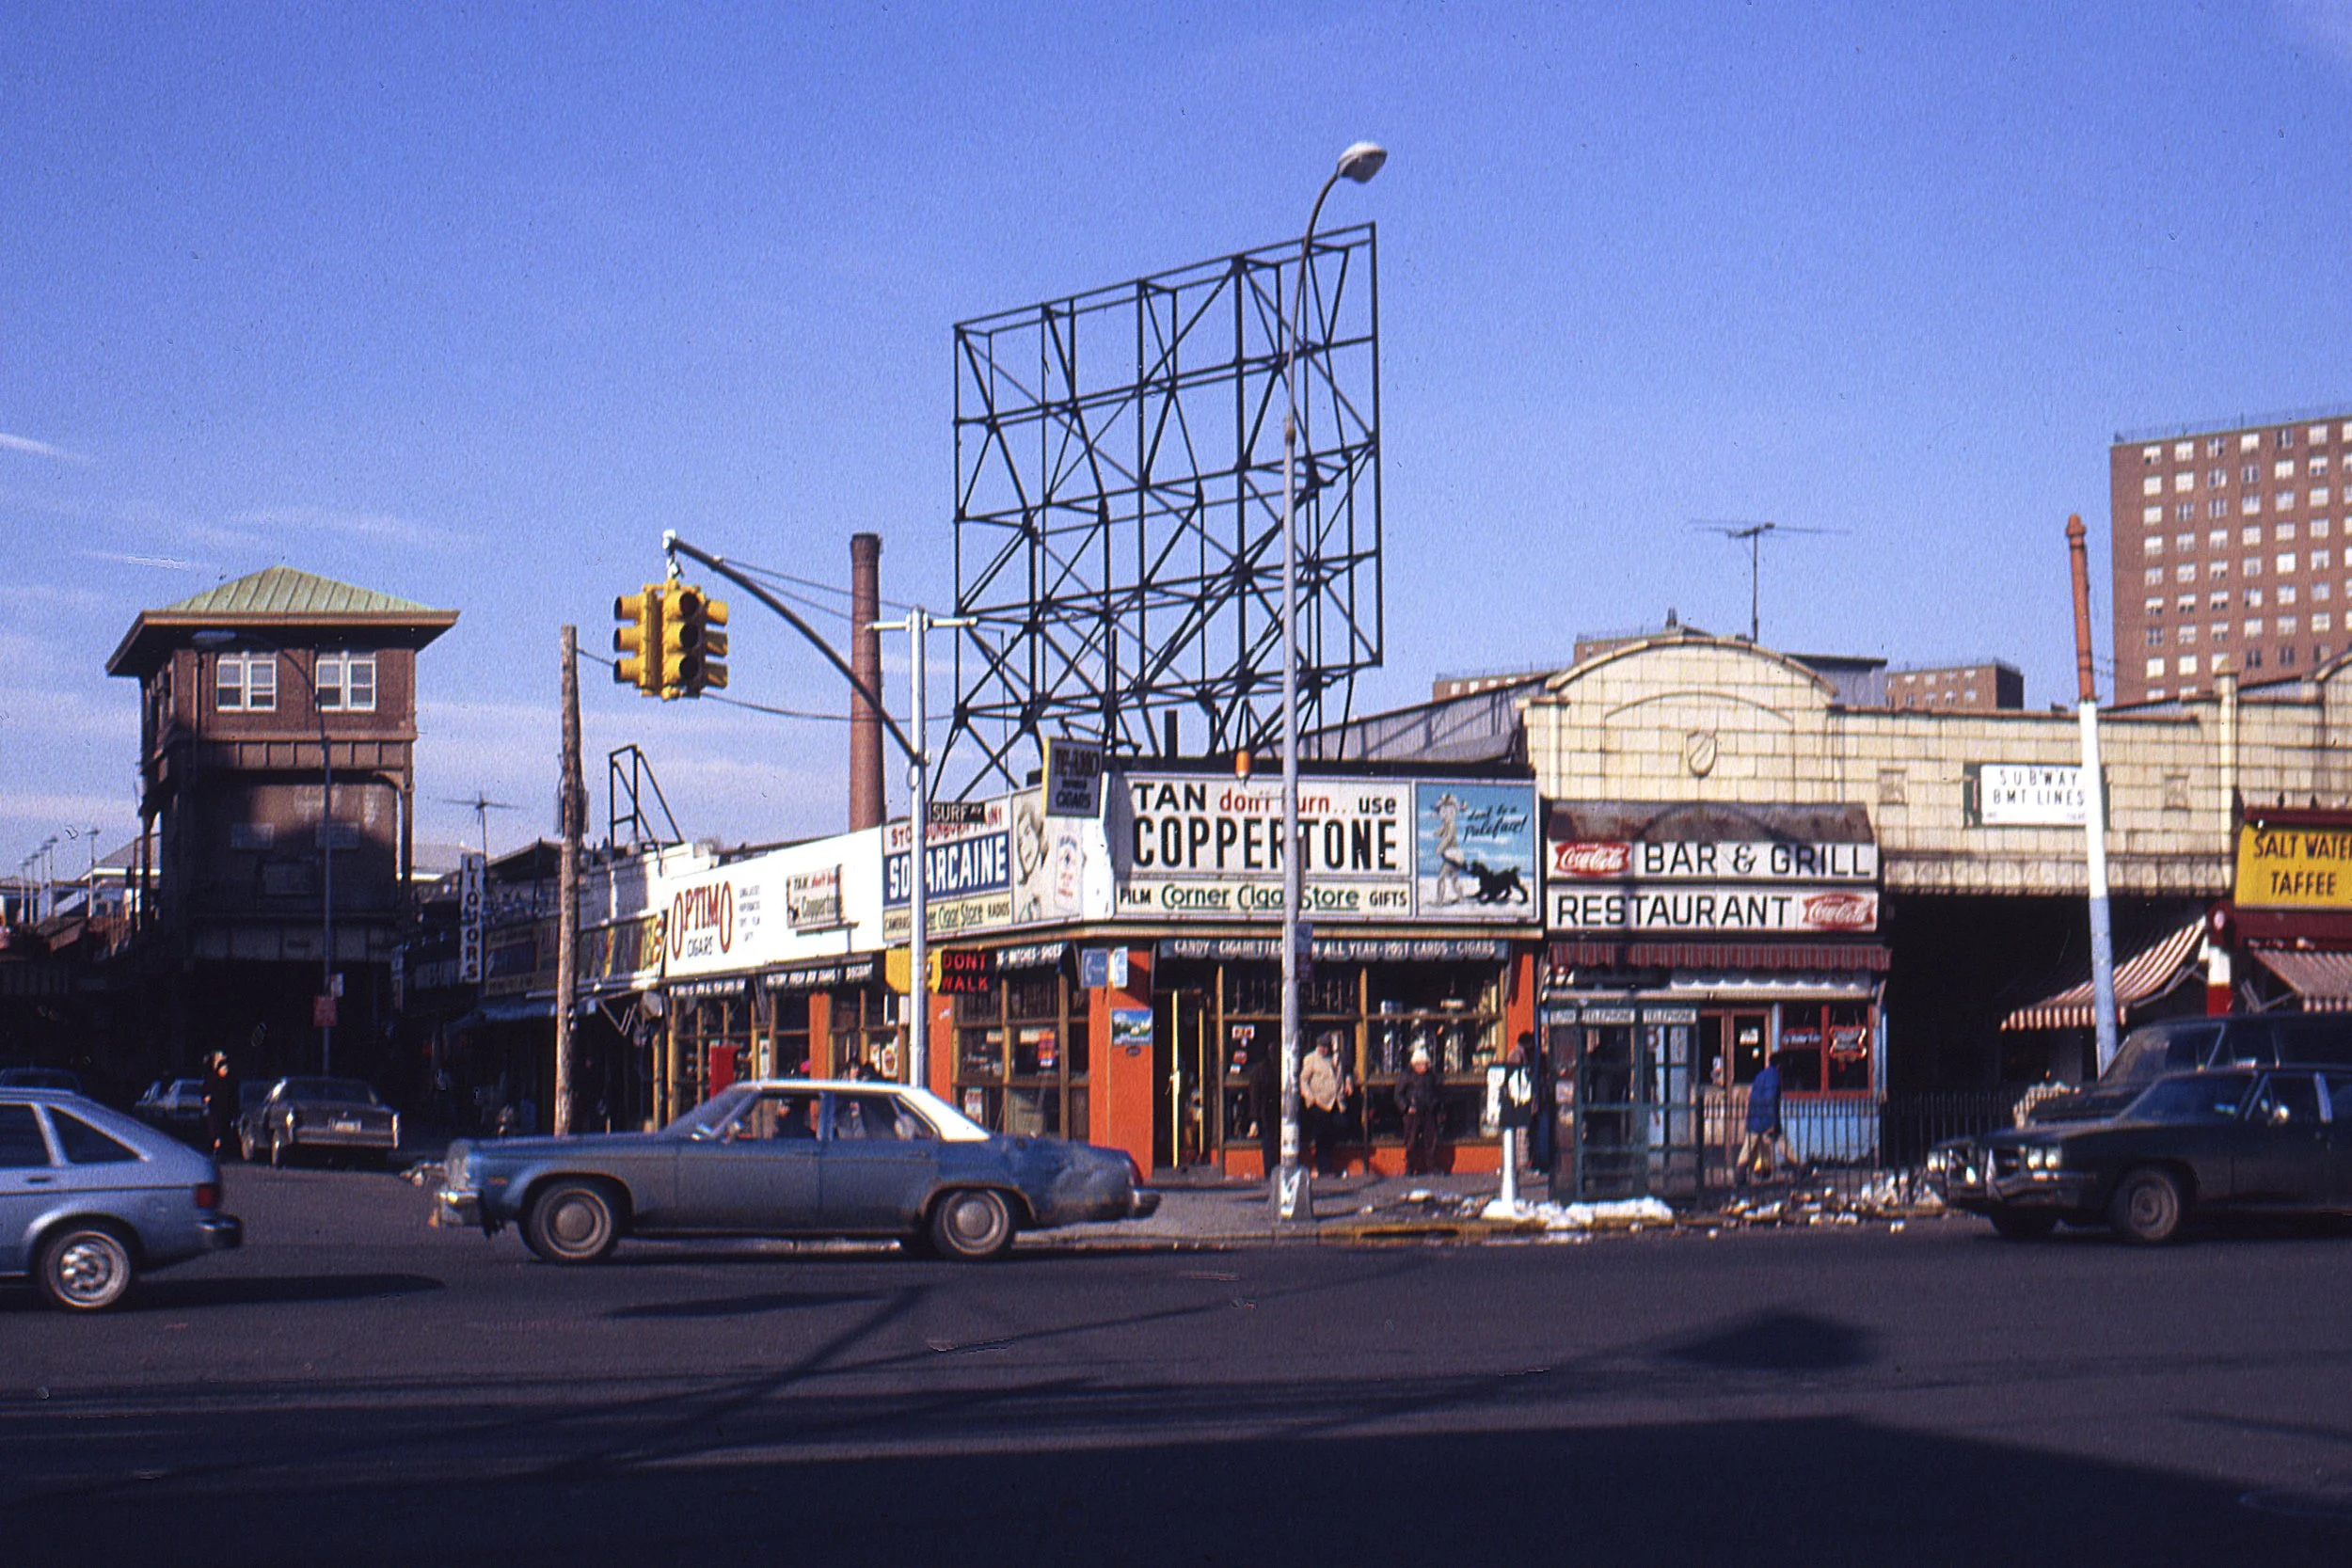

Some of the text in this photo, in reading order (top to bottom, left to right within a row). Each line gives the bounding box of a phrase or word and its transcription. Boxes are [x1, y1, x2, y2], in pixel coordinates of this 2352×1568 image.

[2000, 768, 2076, 786] SUBWAY
[1133, 782, 1206, 811] TAN
[1359, 795, 1396, 815] use
[1993, 788, 2085, 806] BMT LINES
[932, 803, 968, 822] SURF
[891, 825, 912, 847] STO
[1133, 816, 1396, 869] COPPERTONE
[2253, 832, 2297, 859] SALT
[889, 834, 1007, 900] SOARCAINE
[1645, 843, 1870, 877] BAR & GRILL
[2271, 870, 2336, 895] TAFFEE
[1120, 887, 1152, 905] FILM
[1161, 883, 1231, 910] Corner
[1237, 884, 1283, 911] Ciga
[1369, 890, 1406, 908] GIFTS
[672, 880, 733, 961] OPTIMO
[1558, 895, 1791, 927] RESTAURANT
[687, 935, 713, 958] CIGARS
[1174, 941, 1209, 954] CANDY
[1324, 942, 1344, 956] ALL
[1349, 942, 1377, 957] YEAR
[1384, 942, 1409, 957] POST
[1413, 942, 1448, 957] CARDS
[1456, 942, 1495, 957] CIGARS
[942, 953, 986, 971] DONT
[941, 974, 988, 993] WALK
